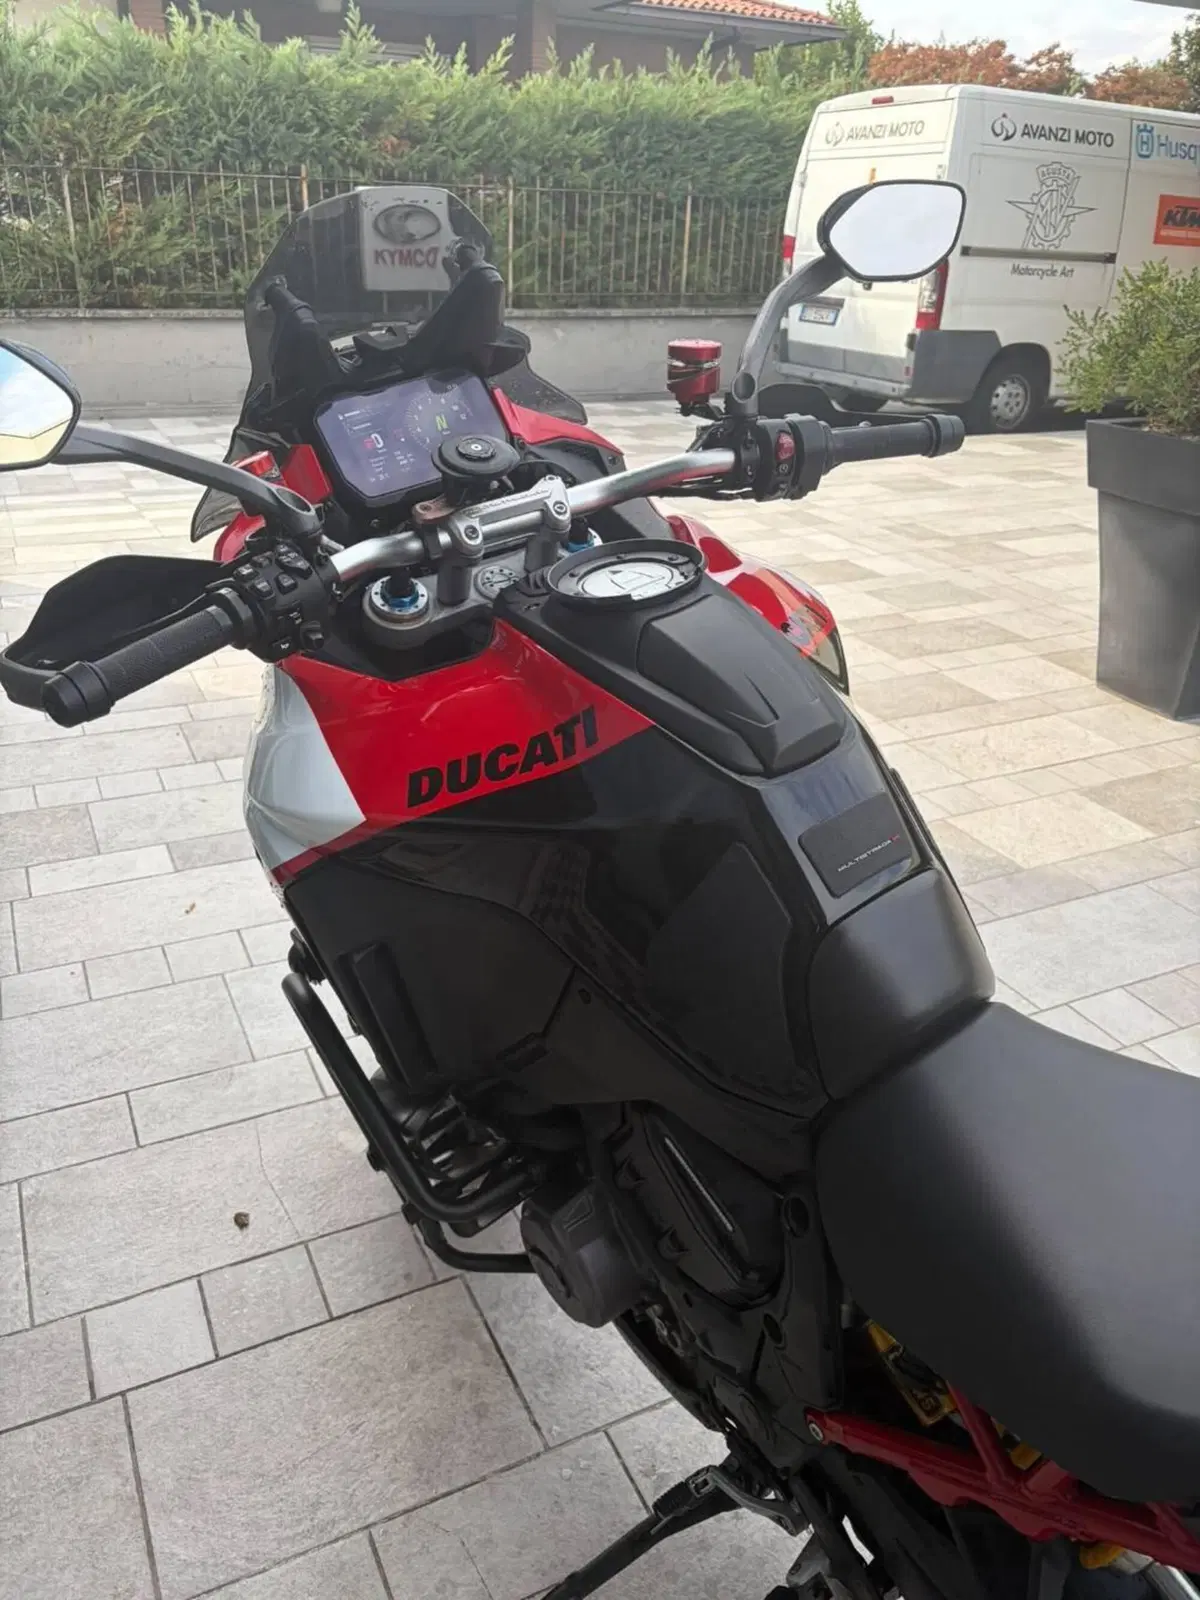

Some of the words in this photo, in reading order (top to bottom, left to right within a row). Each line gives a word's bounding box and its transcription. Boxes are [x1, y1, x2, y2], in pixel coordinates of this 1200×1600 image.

[846, 124, 887, 141] AVANZI
[888, 119, 925, 137] MOTO
[1020, 123, 1071, 143] AVANZI
[1074, 129, 1114, 148] MOTO
[1010, 263, 1058, 280] Motorcycle
[1059, 265, 1075, 278] Art
[407, 705, 599, 808] DUCATI
